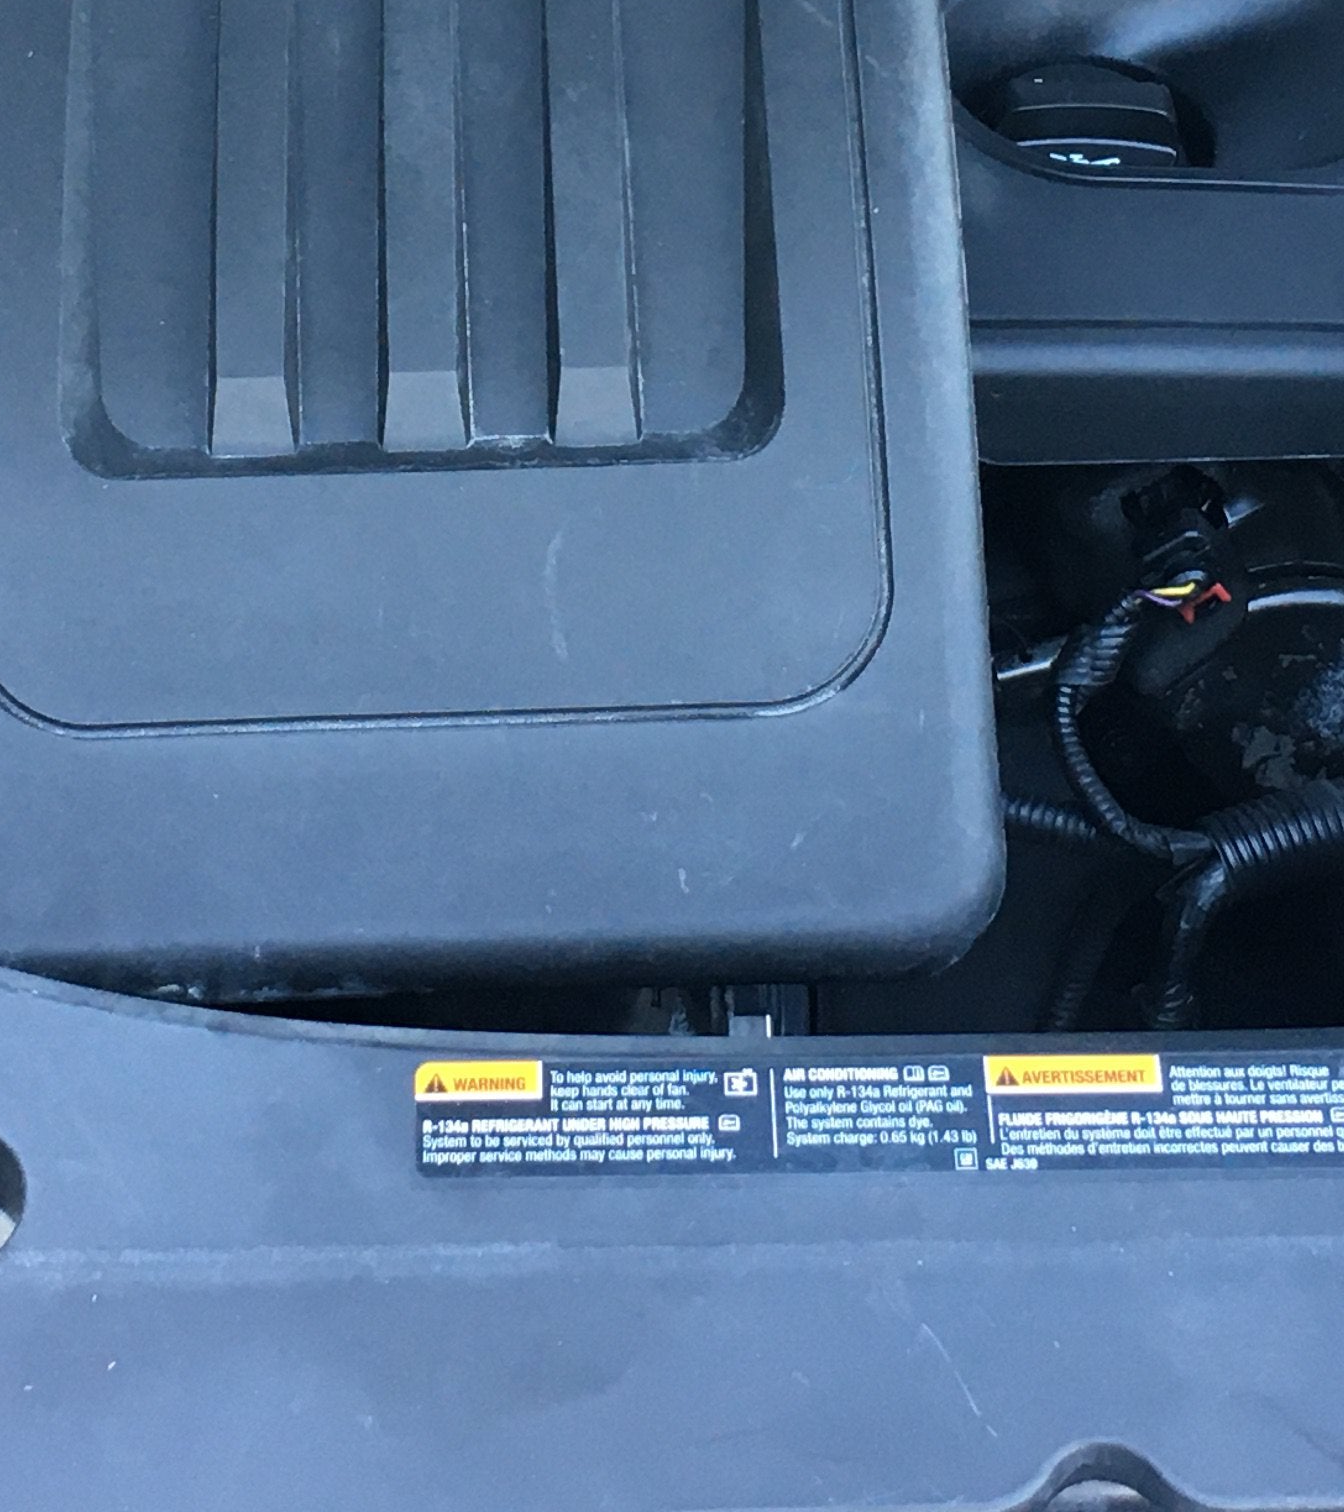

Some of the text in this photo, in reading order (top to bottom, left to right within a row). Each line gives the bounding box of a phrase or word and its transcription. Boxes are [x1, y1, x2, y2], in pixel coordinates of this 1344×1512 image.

[550, 1070, 564, 1084] To
[566, 1070, 592, 1086] help
[595, 1069, 626, 1084] avoid
[629, 1069, 680, 1085] personal
[783, 1066, 899, 1081] AIR CONDITIONING
[1022, 1069, 1146, 1085] AVERTISSEMENT
[1169, 1064, 1330, 1080] Attention aux doigts! Risque
[453, 1077, 526, 1091] WARNING
[550, 1083, 690, 1099] keep hands clear of fan.
[1170, 1079, 1187, 1092] de
[1188, 1078, 1248, 1092] blessures.
[1249, 1078, 1265, 1091] Le
[1266, 1078, 1329, 1091] ventilateur
[784, 1084, 972, 1102] Use only R-134a Refrigerant and
[1173, 1093, 1212, 1106] mettre
[1214, 1092, 1223, 1105] à
[1224, 1092, 1266, 1105] tourner
[1269, 1092, 1298, 1105] sans
[550, 1098, 685, 1112] It can start at any time.
[784, 1099, 967, 1117] Polyalkylene Glycol oil (PAG oil).
[422, 1116, 710, 1134] R-134a REFRIGERANT UNDER HIGH PRESSURE
[786, 1115, 933, 1132] The system contains dye.
[998, 1109, 1323, 1126] FLUIDE FRIGORIGÈNE R-134a SOUS HAUTE PRESSION
[422, 1131, 715, 1150] System to be serviced by qualified personnel only.
[786, 1130, 977, 1147] System charge: 0.65 kg (1.43 lb)
[999, 1127, 1062, 1141] L'entretien
[1063, 1127, 1079, 1140] du
[1081, 1126, 1131, 1142] système
[1133, 1126, 1156, 1139] doit
[1158, 1126, 1183, 1139] être
[1185, 1125, 1233, 1140] effectué
[1235, 1127, 1254, 1141] par
[1258, 1127, 1273, 1139] un
[1276, 1125, 1334, 1140] personnel
[422, 1146, 737, 1166] Improper service methods may cause personal injury.
[1001, 1142, 1025, 1156] Des
[1027, 1142, 1085, 1156] méthodes
[1087, 1141, 1151, 1155] d'entretien
[1153, 1140, 1219, 1155] incorrectes
[1221, 1141, 1268, 1156] peuvent
[1270, 1140, 1311, 1154] causer
[1313, 1139, 1335, 1153] des
[985, 1157, 1008, 1170] SAE
